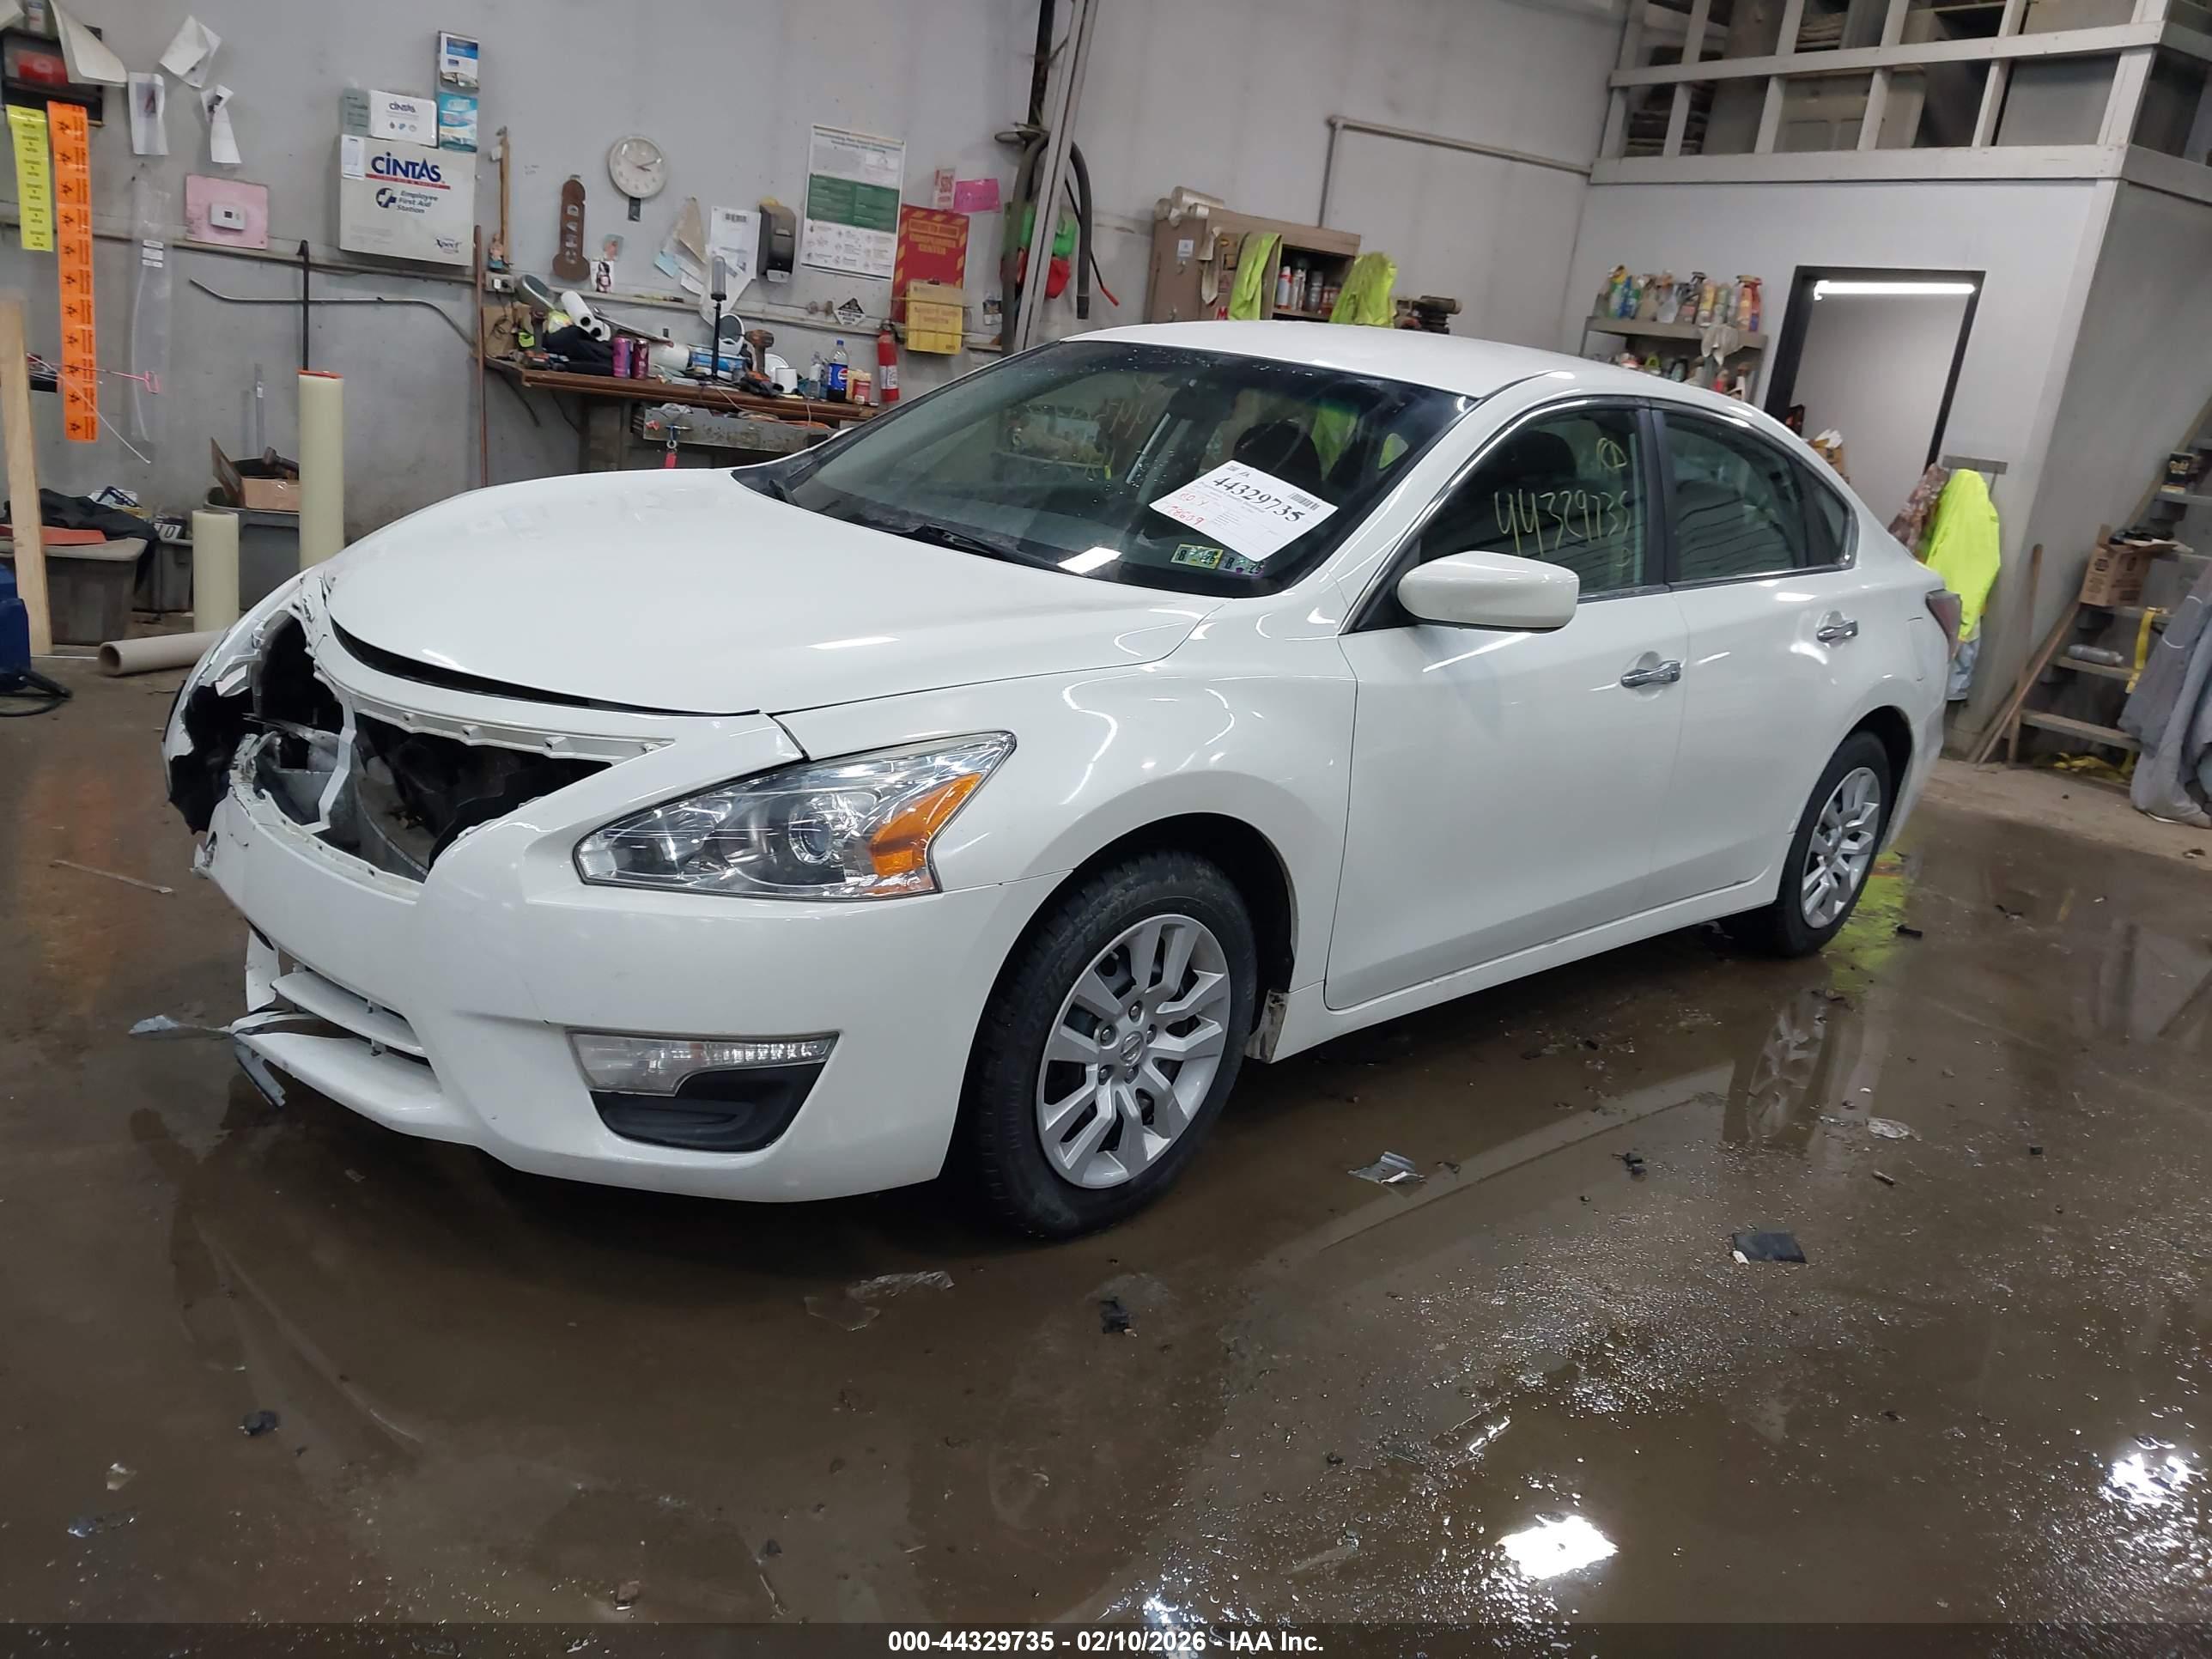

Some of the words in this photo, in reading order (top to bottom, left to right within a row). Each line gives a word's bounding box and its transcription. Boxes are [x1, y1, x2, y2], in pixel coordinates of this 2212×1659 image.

[398, 198, 416, 206] First
[400, 190, 439, 202] Employee
[396, 204, 426, 214] Station
[1212, 477, 1306, 522] 44329735
[1493, 488, 1631, 556] 44329735
